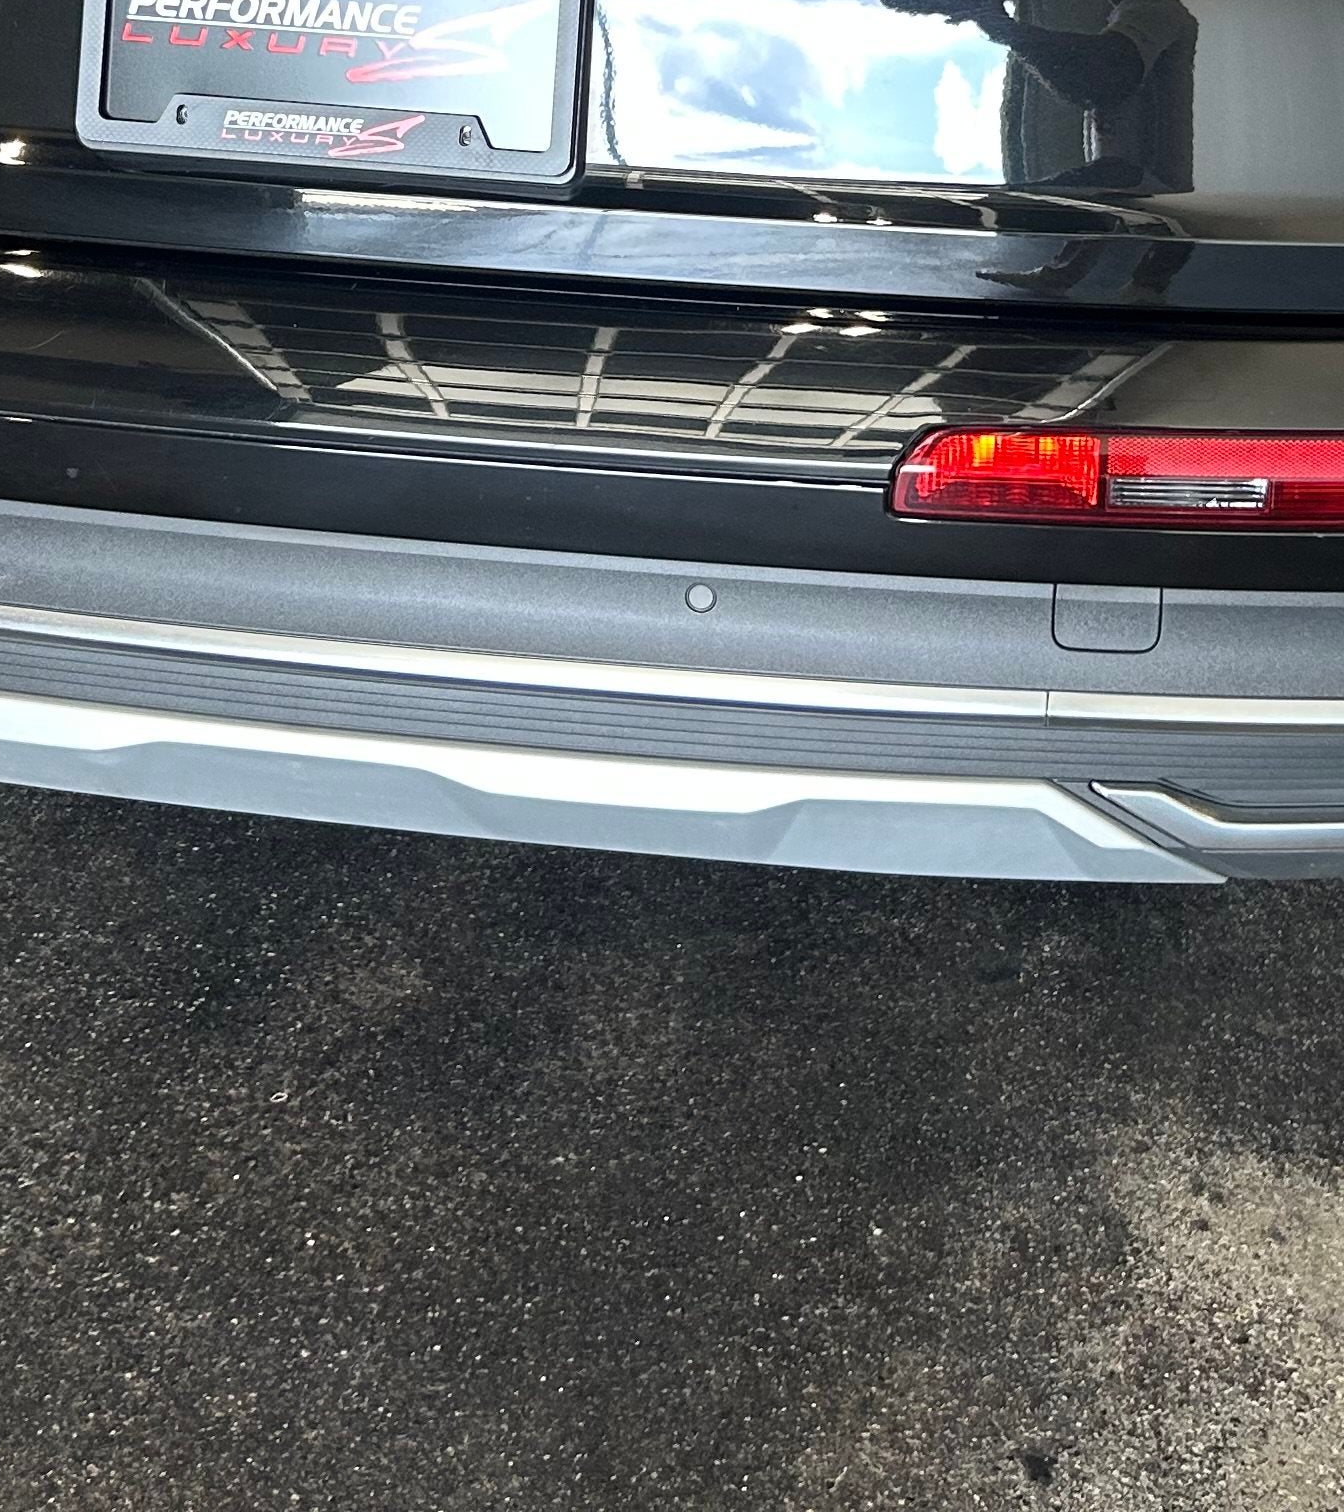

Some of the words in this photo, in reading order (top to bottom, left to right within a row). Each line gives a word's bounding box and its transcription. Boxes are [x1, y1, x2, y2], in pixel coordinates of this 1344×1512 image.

[121, 22, 408, 61] LUXURY
[223, 110, 365, 134] PERFORMANCE
[221, 128, 355, 147] LUXURY
